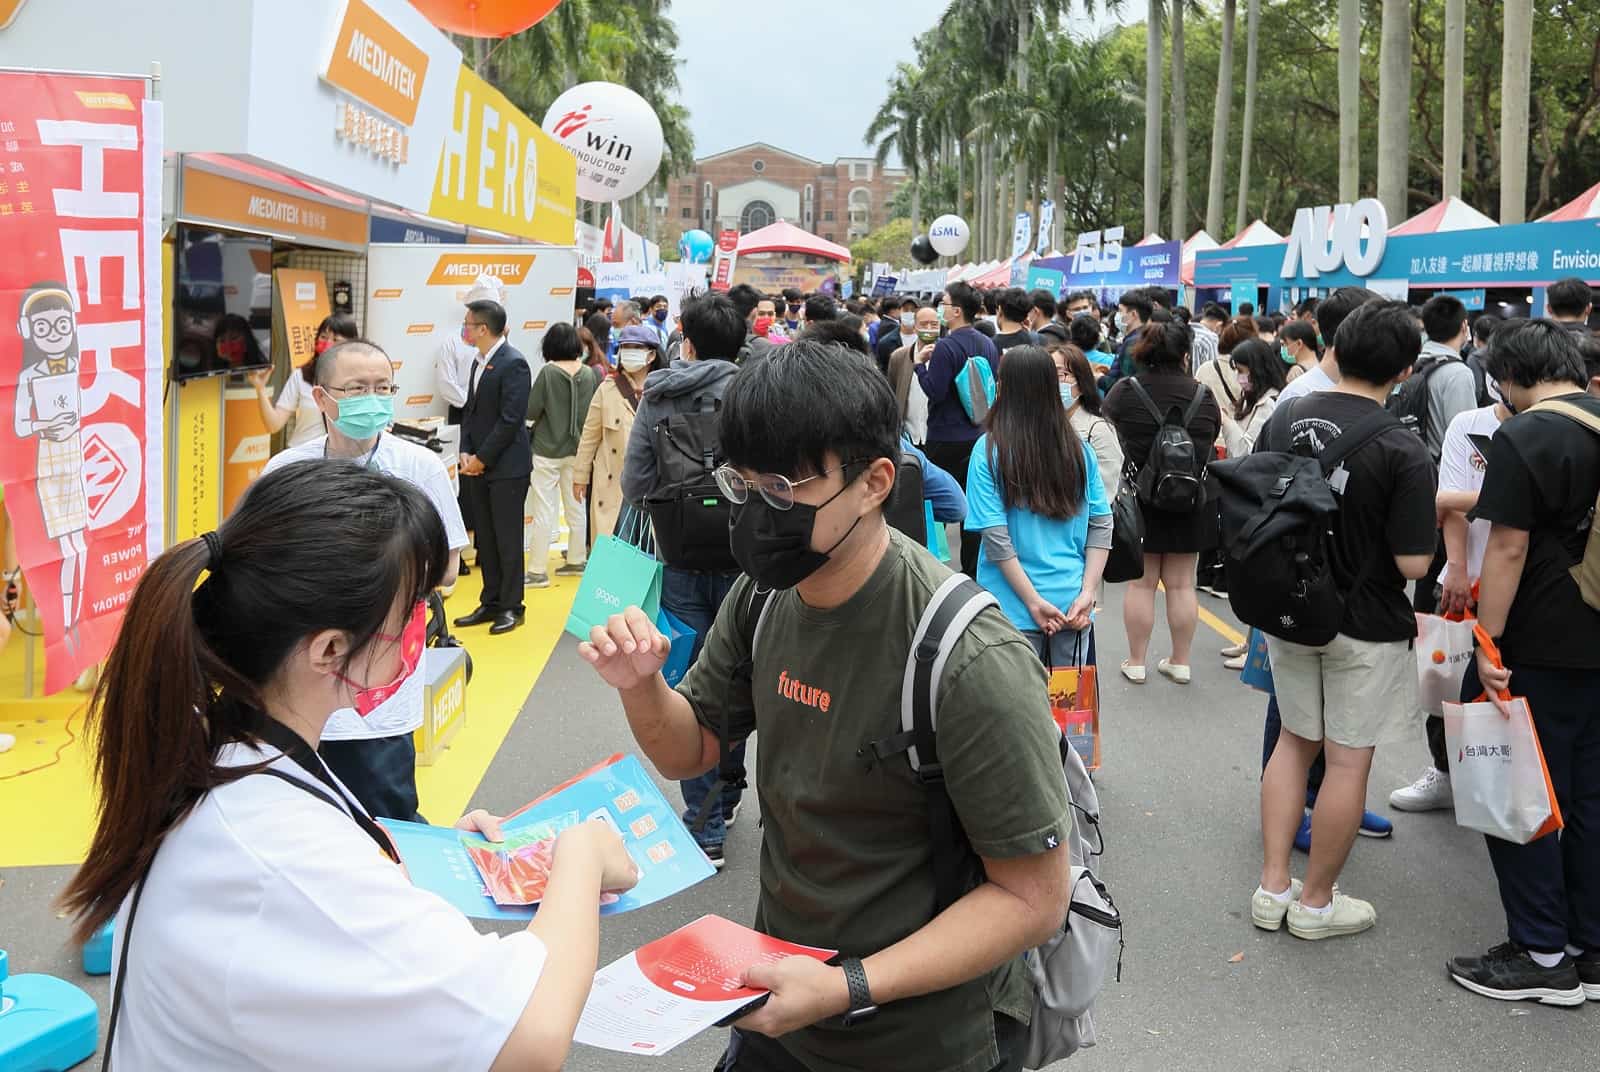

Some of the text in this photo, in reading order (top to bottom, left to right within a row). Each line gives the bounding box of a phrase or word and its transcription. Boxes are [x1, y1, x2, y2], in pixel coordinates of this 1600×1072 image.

[347, 29, 416, 100] MEDIATEK
[440, 90, 538, 224] HERO
[560, 143, 627, 175] CONDUCTORS
[587, 131, 632, 161] win
[248, 196, 298, 224] MEDIATEK
[1280, 198, 1388, 279] AUO
[443, 263, 521, 276] MEDIATEK
[1553, 250, 1600, 269] Envisio
[777, 669, 832, 713] future
[433, 680, 463, 736] HERO
[1464, 744, 1512, 758] 台灣大哥
